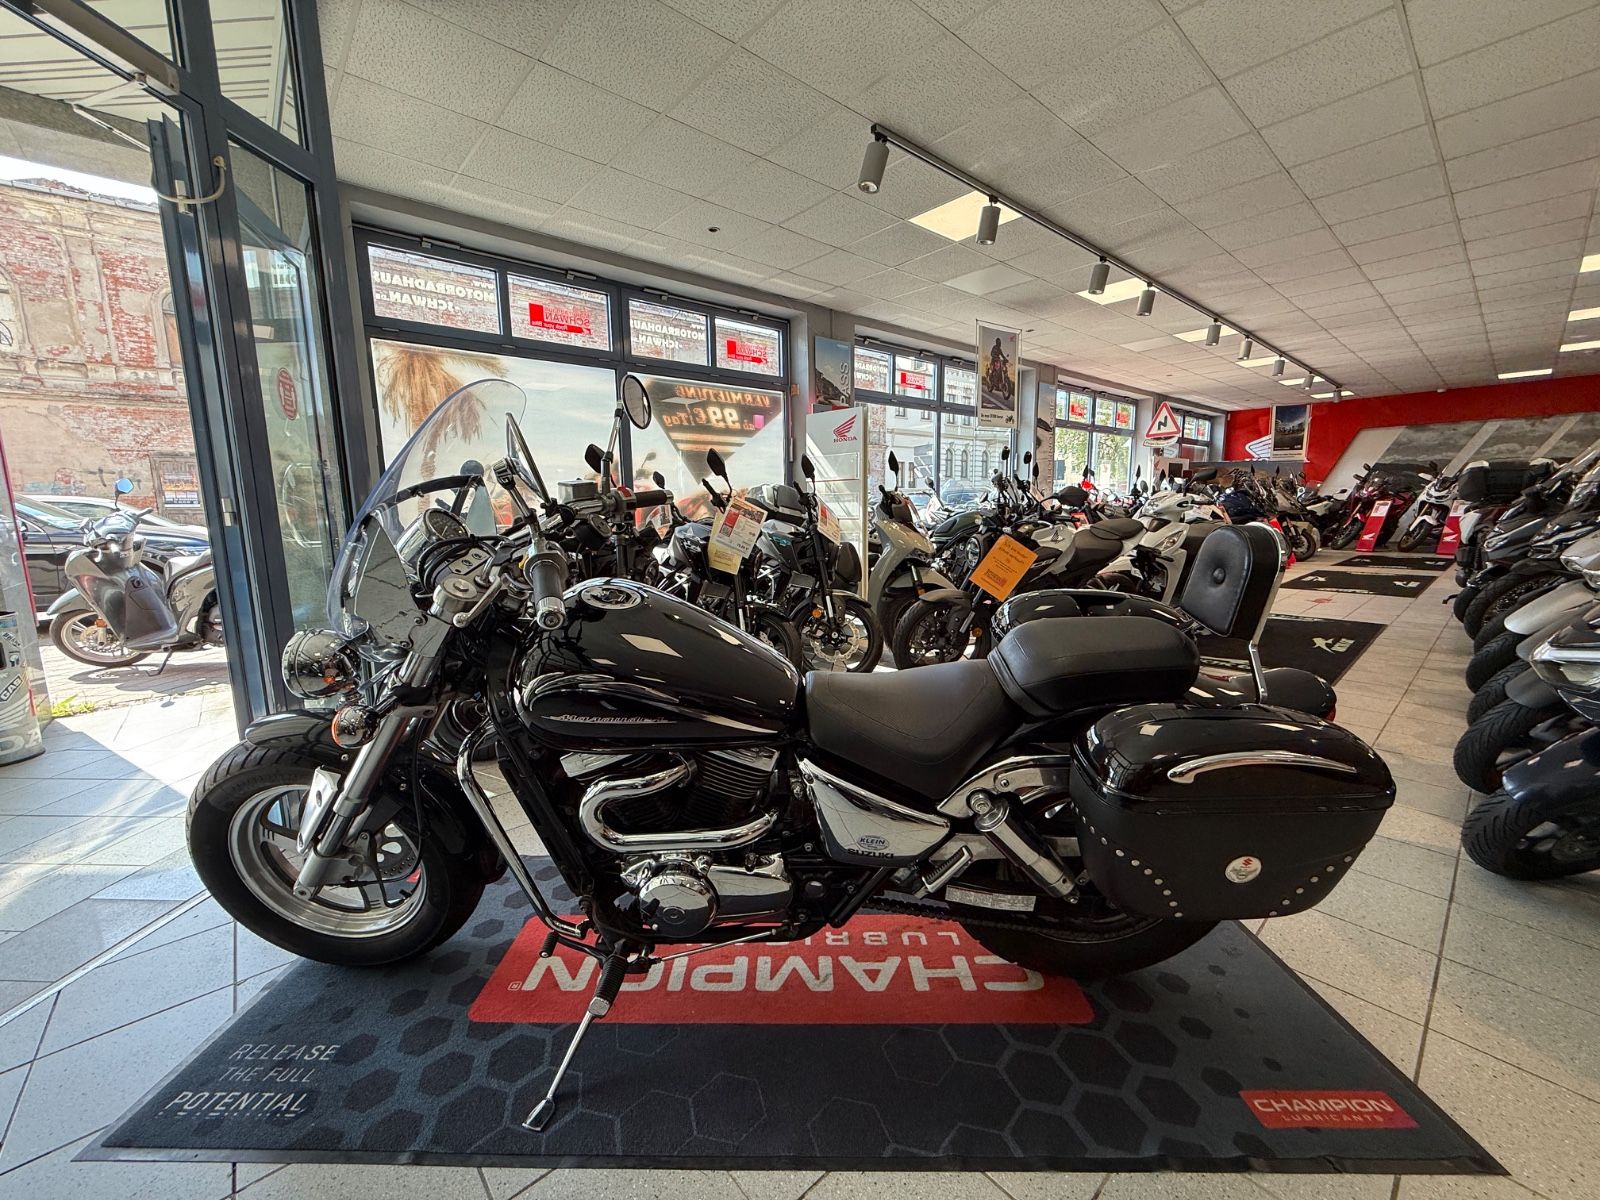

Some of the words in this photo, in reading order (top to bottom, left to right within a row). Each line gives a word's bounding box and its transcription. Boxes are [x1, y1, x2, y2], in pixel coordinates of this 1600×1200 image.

[833, 435, 857, 443] HONDA
[859, 837, 886, 845] KLEIN
[847, 848, 894, 859] SUZUKI
[229, 1043, 341, 1061] RELEASE
[218, 1067, 264, 1082] THE
[262, 1067, 315, 1083] FULL
[165, 1091, 309, 1111] POTENTIAL
[1253, 1098, 1395, 1113] CHAMPION
